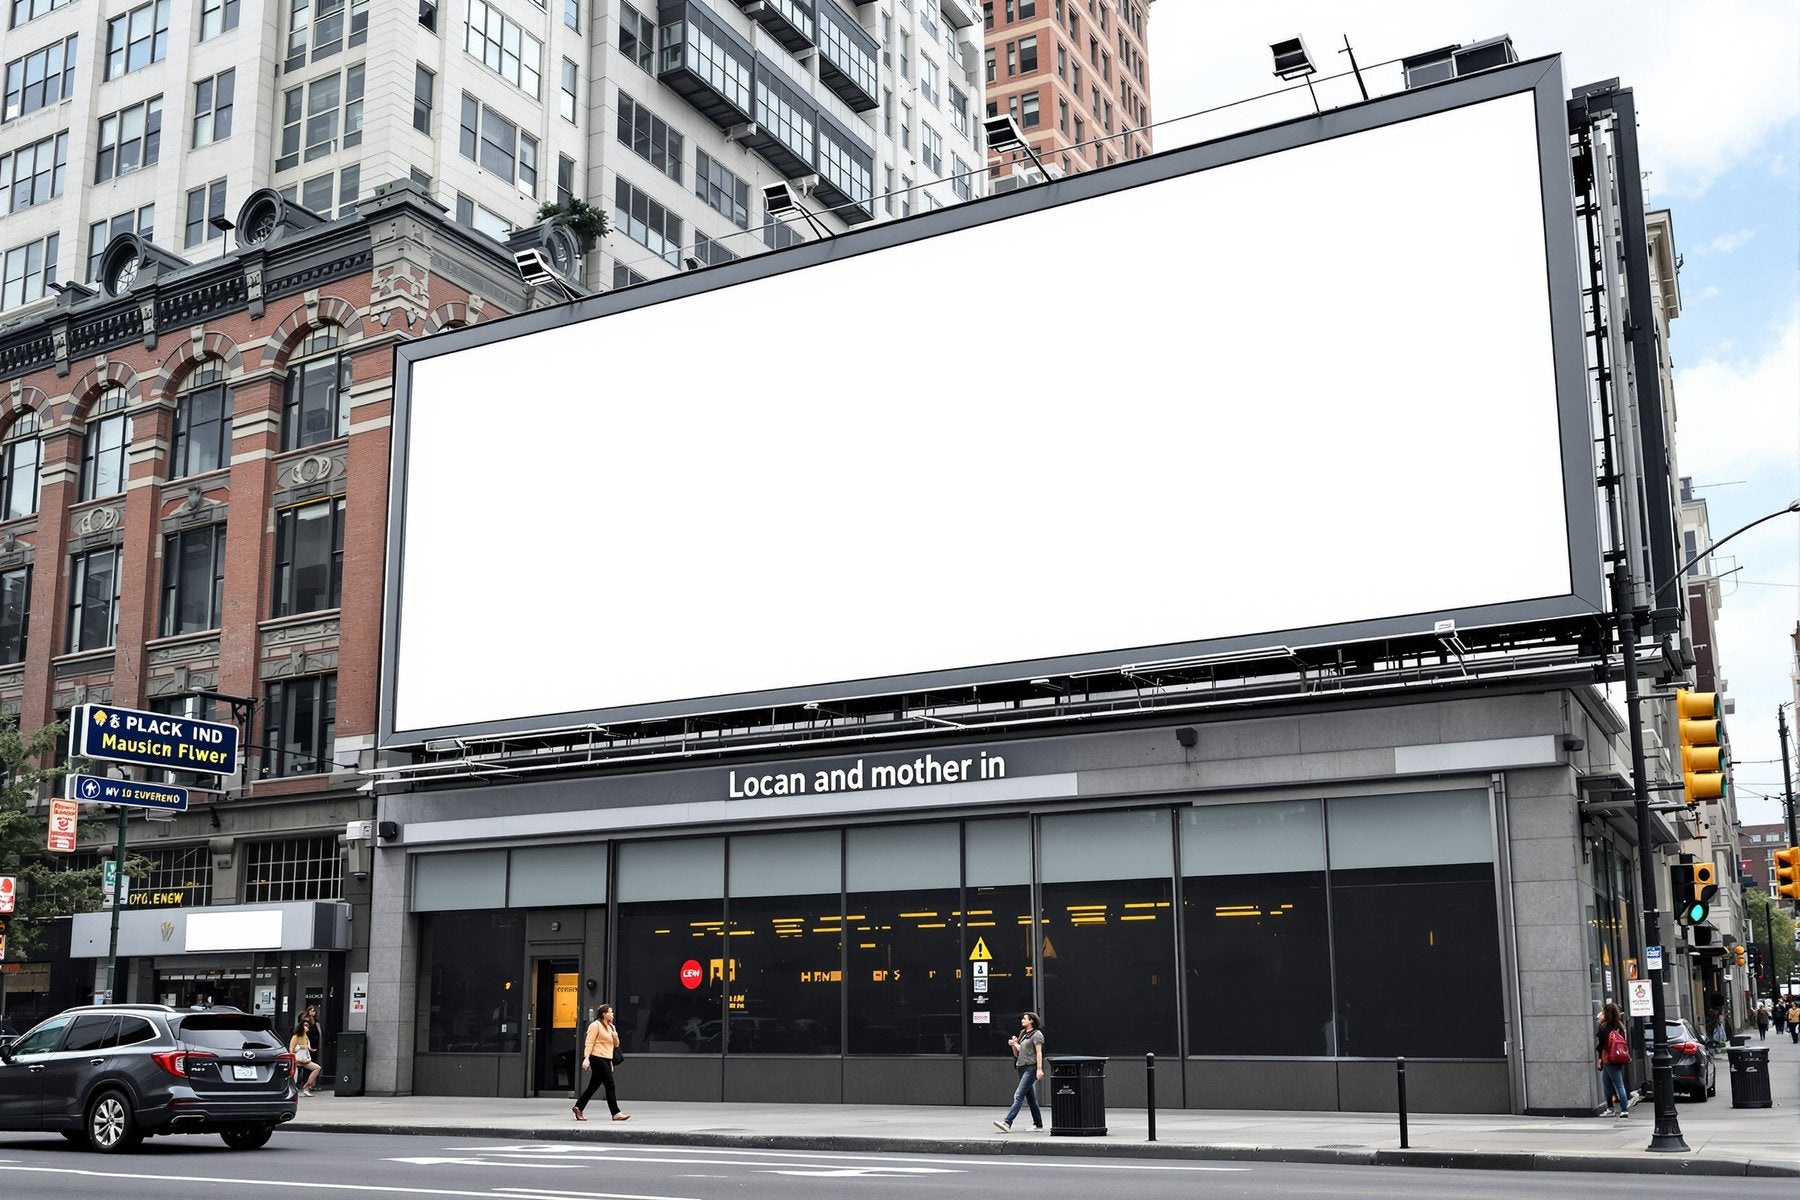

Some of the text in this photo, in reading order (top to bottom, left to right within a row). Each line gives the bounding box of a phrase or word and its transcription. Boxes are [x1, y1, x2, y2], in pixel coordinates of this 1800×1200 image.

[126, 716, 223, 744] PLACK IND
[729, 751, 1006, 798] Locan and mother in
